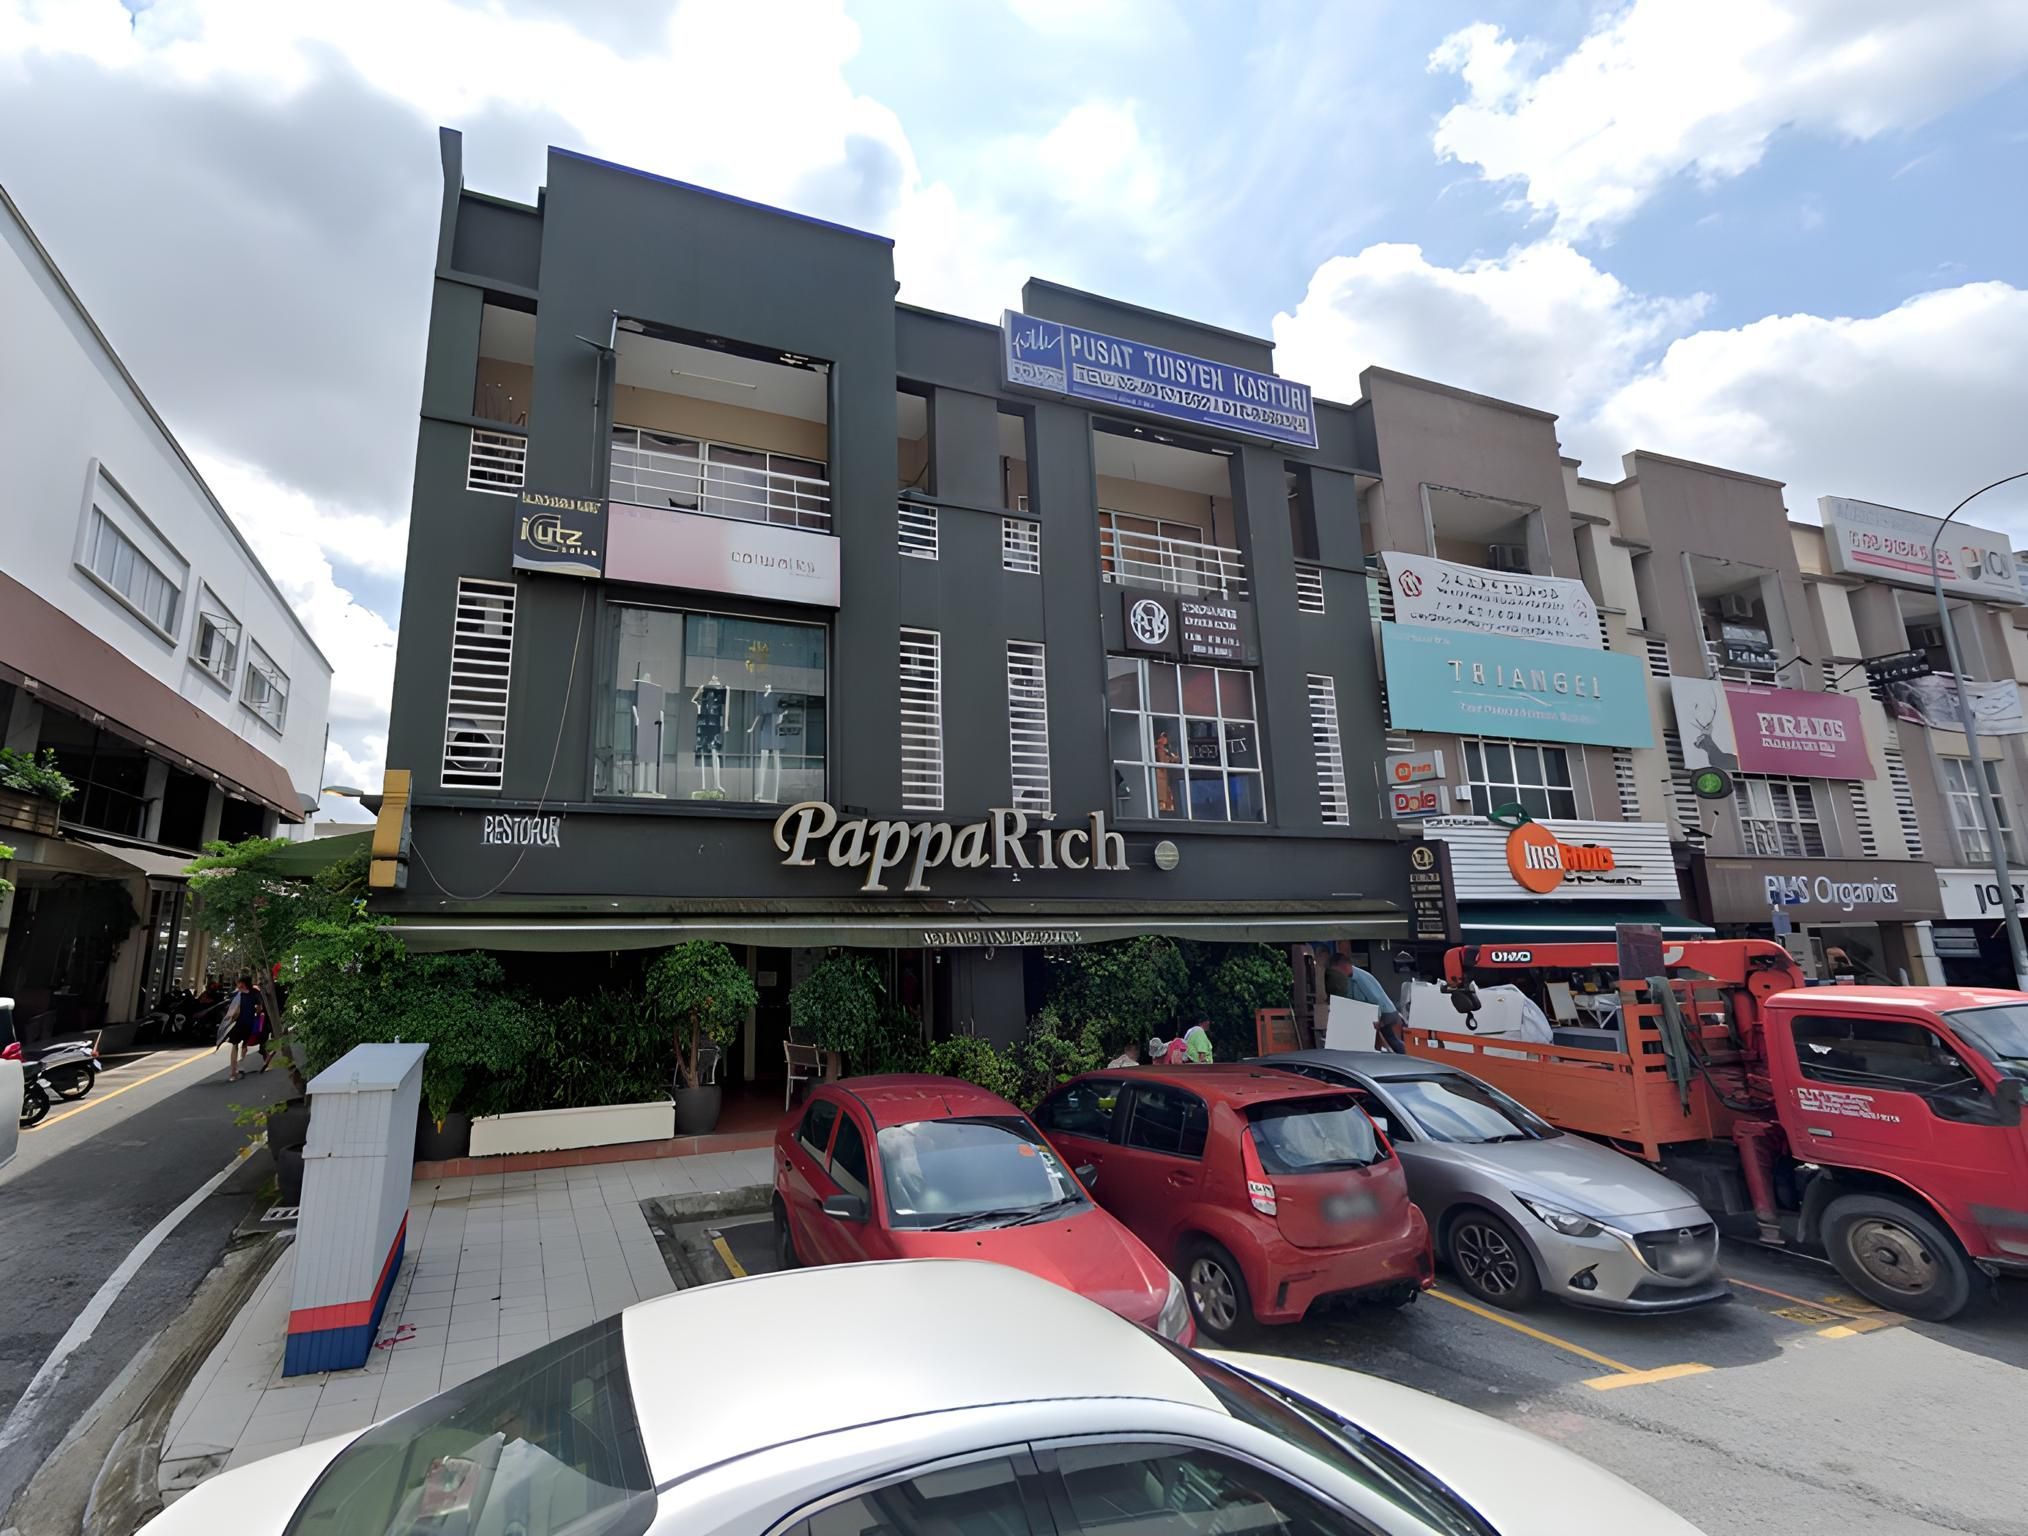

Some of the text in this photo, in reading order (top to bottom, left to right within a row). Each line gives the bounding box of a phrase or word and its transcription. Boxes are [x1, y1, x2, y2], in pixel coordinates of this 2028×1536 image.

[1070, 333, 1133, 370] PUSAT
[1144, 350, 1224, 392] TUISYEN
[1234, 374, 1308, 412] KASTURI
[772, 801, 1131, 893] PappaRich
